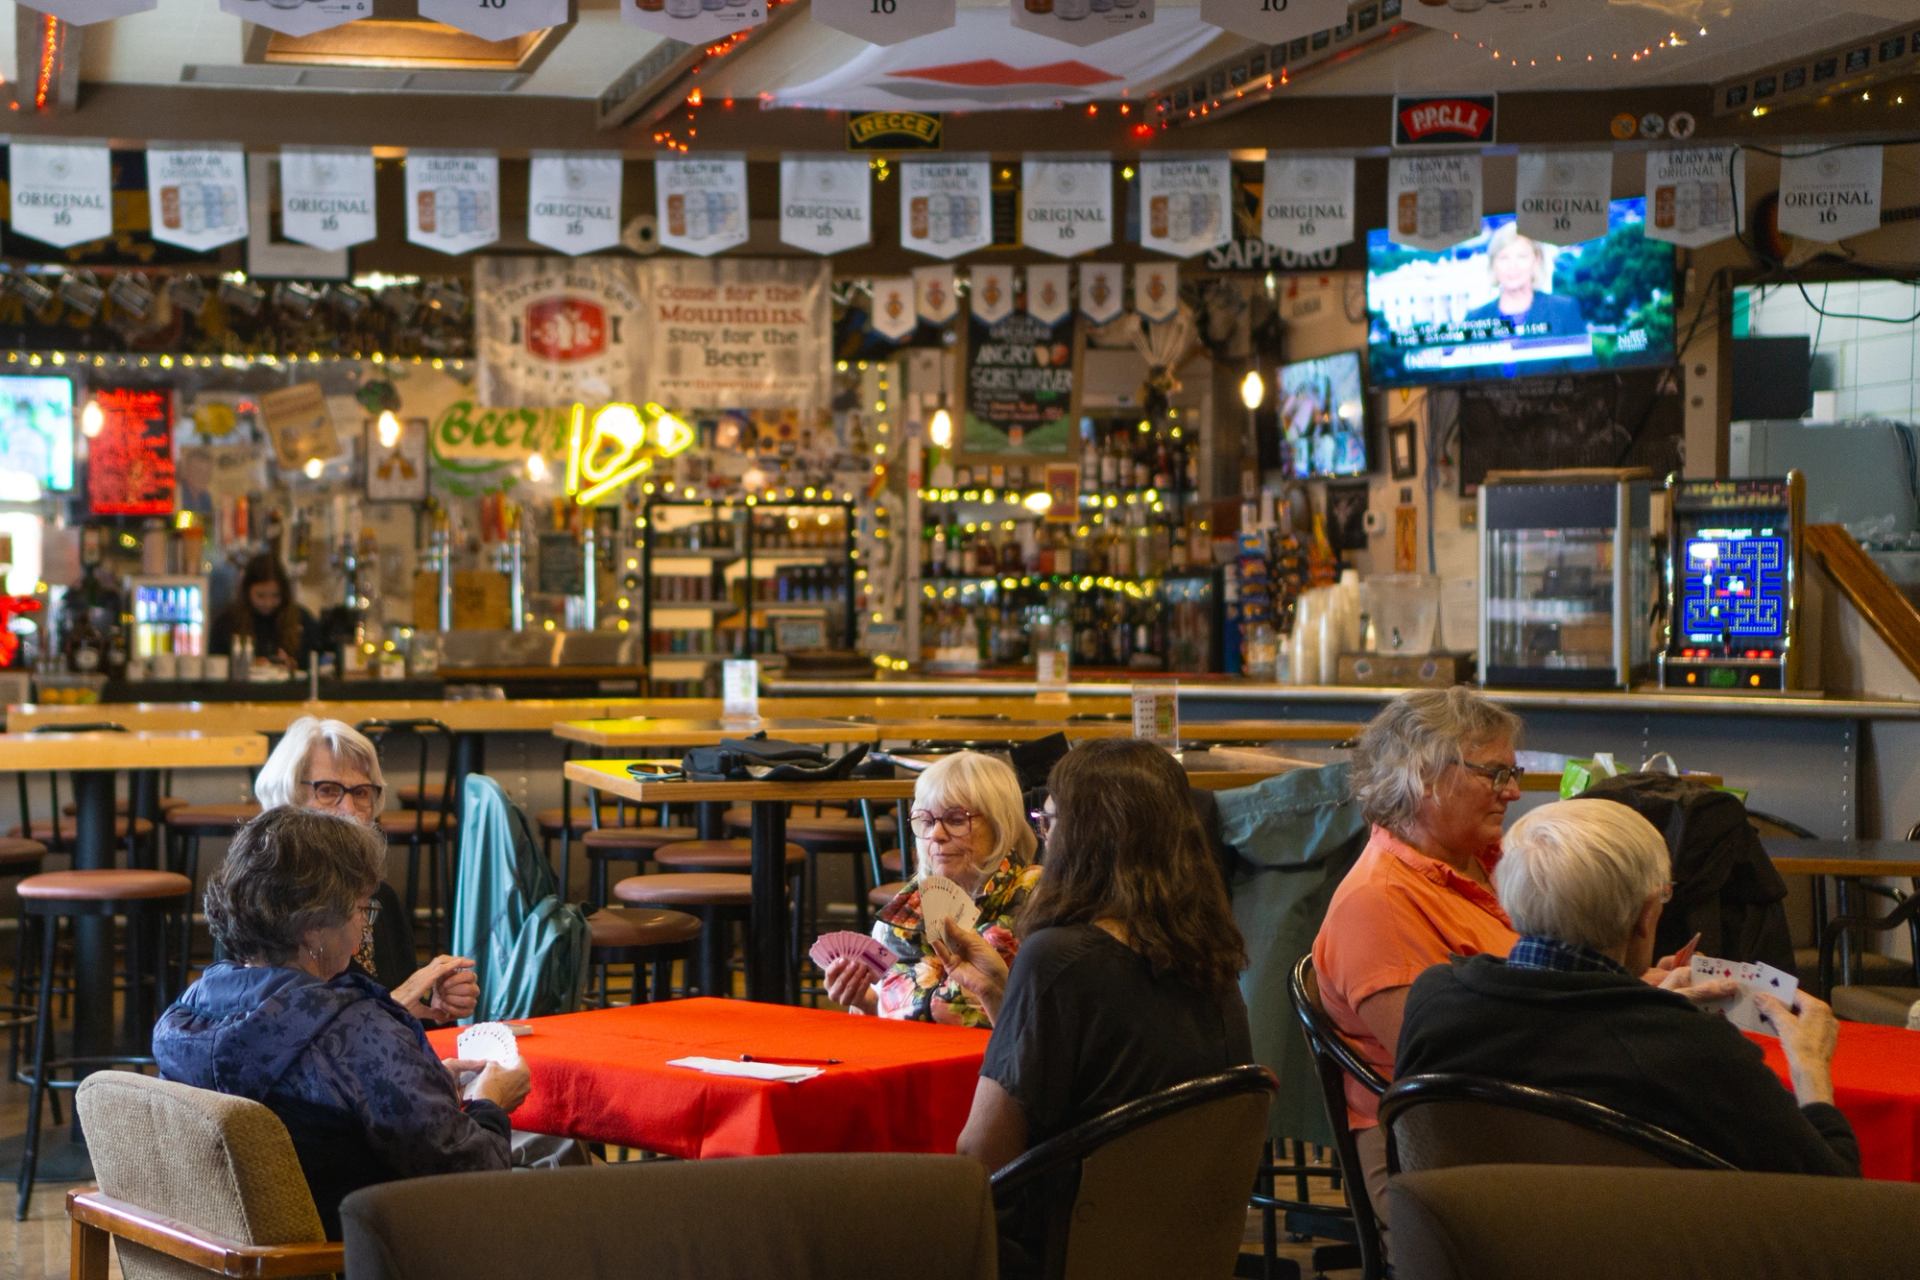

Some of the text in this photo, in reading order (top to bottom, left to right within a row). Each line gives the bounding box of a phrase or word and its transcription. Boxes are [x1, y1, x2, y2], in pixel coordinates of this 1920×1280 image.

[859, 113, 931, 134] RECCE
[17, 190, 104, 209] ORIGINAL
[288, 197, 368, 214] ORIGINAL
[1521, 197, 1605, 214] ORIGINAL
[1784, 190, 1873, 208] ORIGINAL
[53, 208, 72, 227] 16
[535, 202, 614, 220] ORIGINAL
[785, 204, 862, 221] ORIGINAL
[1026, 206, 1106, 222] ORIGINAL
[1267, 203, 1347, 219] ORIGINAL
[1819, 207, 1838, 225] 16
[320, 214, 339, 231] 16
[566, 219, 584, 236] 16
[817, 221, 834, 237] 16
[1058, 223, 1076, 239] 16
[1299, 219, 1317, 237] 16
[1552, 213, 1572, 232] 16
[725, 286, 758, 301] for
[764, 286, 802, 302] the
[668, 328, 799, 349] Stay for the
